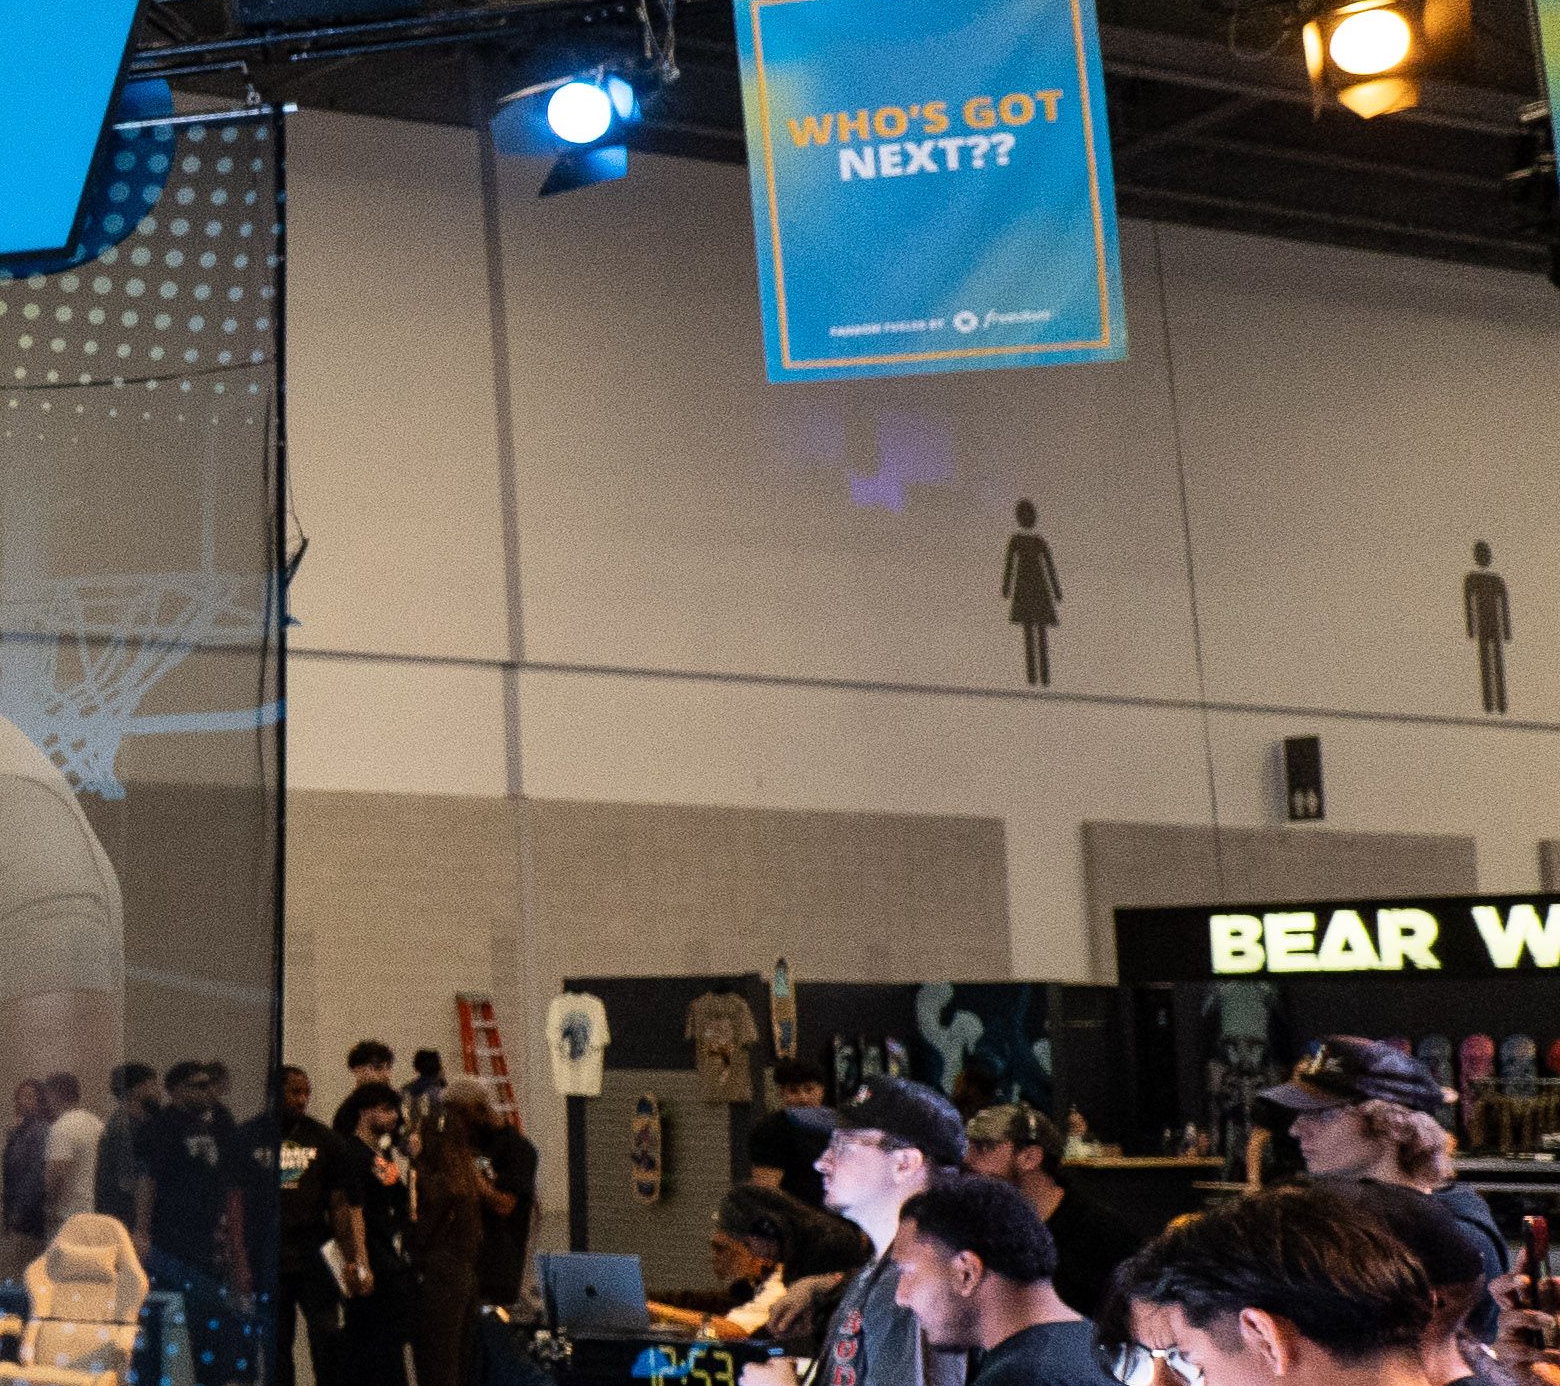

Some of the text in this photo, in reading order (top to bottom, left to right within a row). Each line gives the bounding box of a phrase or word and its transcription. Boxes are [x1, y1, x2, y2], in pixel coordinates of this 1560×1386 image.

[784, 89, 1064, 149] WHO'S GOT
[838, 133, 1016, 182] NEXT??
[1208, 908, 1440, 974] BEAR
